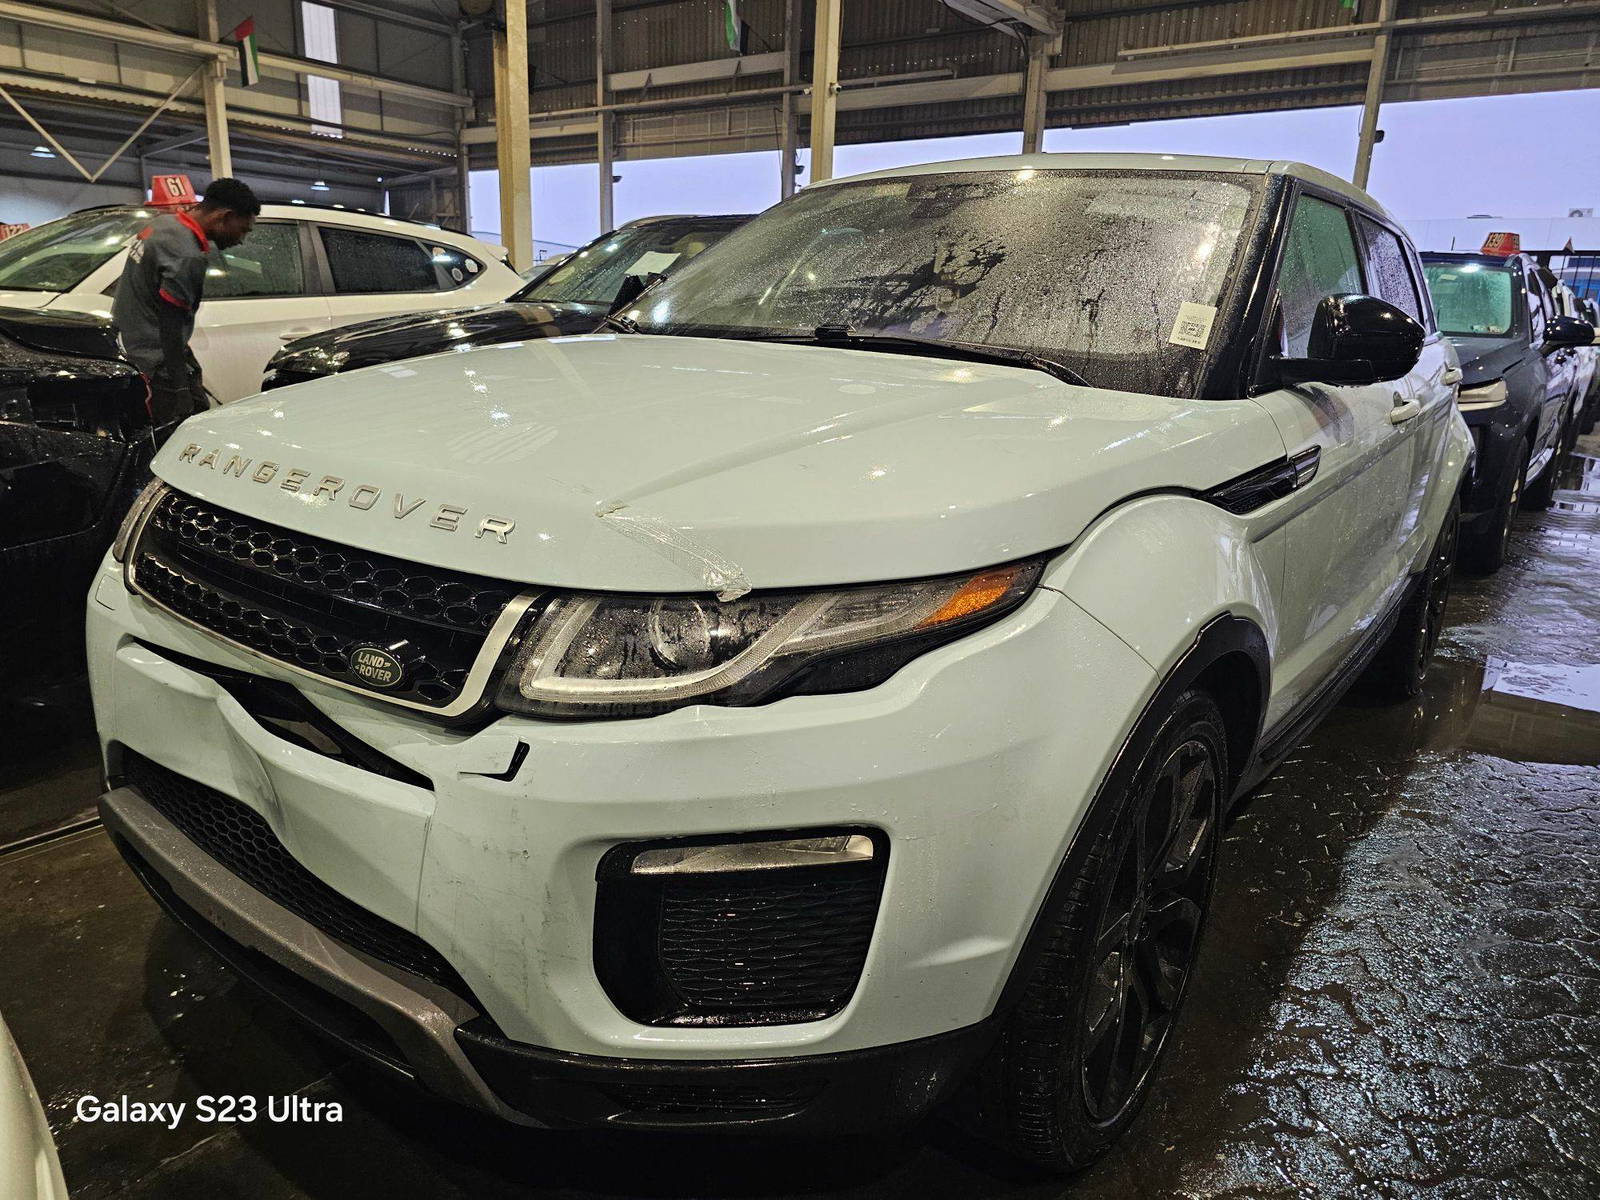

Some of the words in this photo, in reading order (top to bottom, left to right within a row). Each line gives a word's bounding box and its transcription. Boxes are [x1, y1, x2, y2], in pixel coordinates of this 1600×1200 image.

[165, 177, 187, 198] 61
[358, 652, 385, 668] LAND
[359, 663, 392, 682] ROVER
